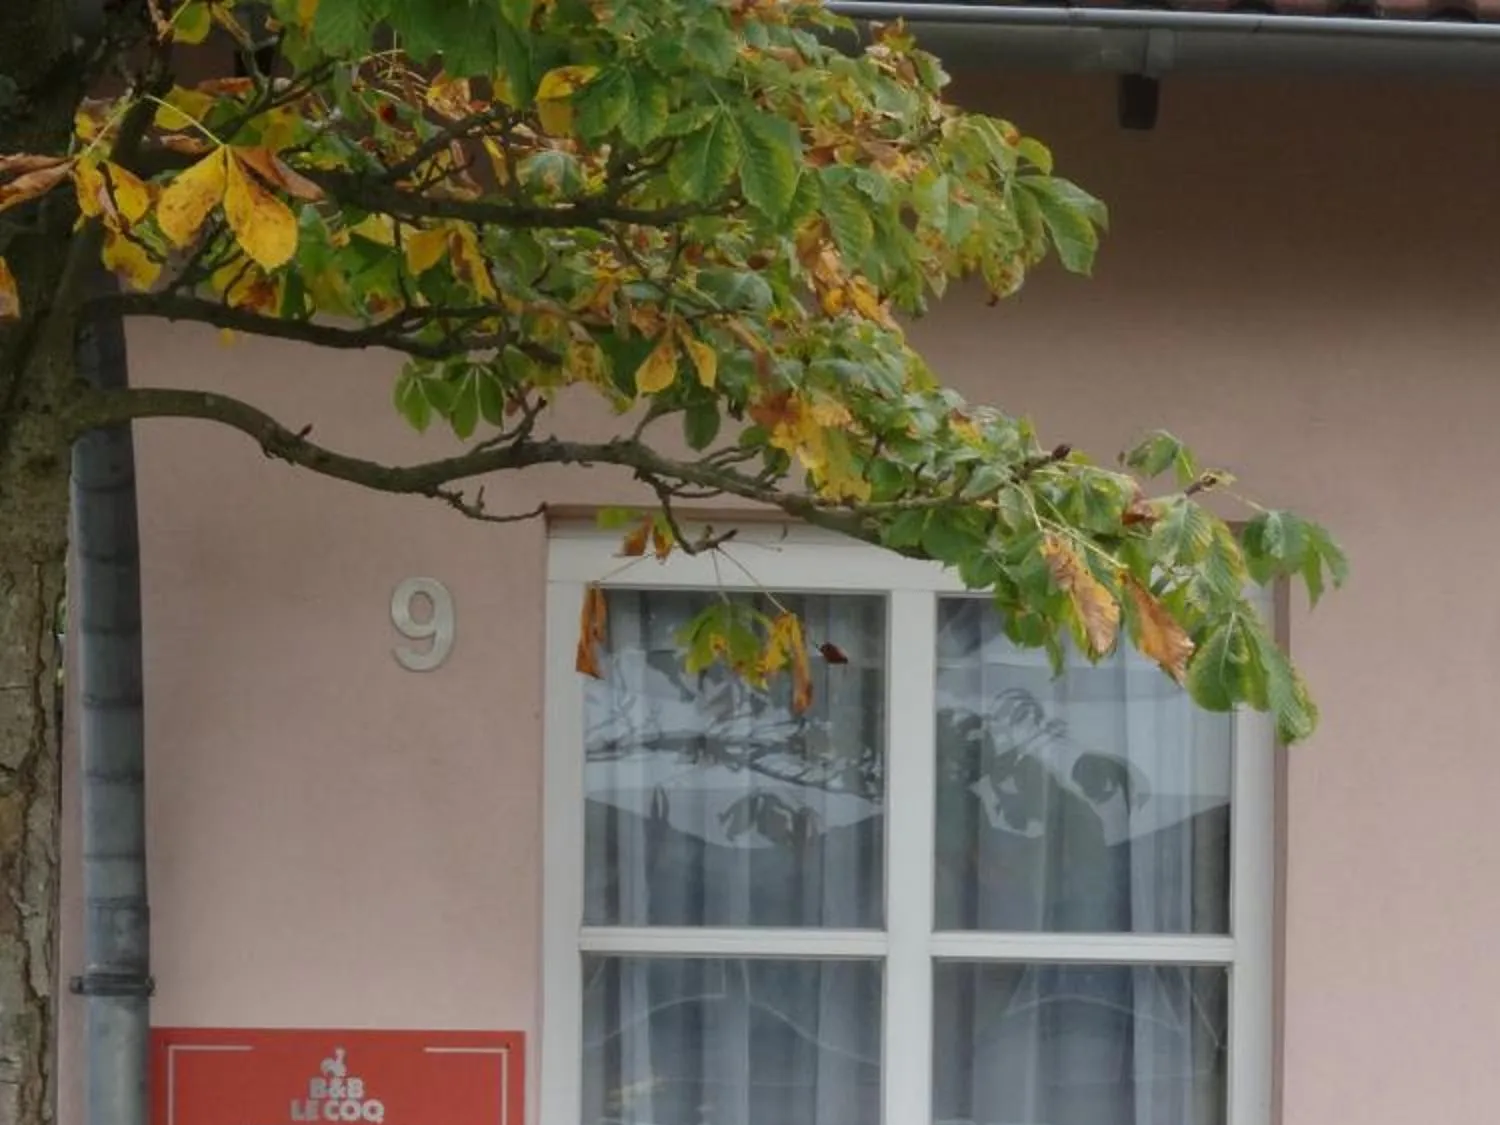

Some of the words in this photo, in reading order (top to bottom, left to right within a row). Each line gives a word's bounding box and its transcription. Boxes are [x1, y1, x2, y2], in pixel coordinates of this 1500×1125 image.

[390, 577, 455, 672] 9
[309, 1077, 365, 1099] B&B
[290, 1100, 319, 1121] LE
[324, 1099, 385, 1124] COQ
